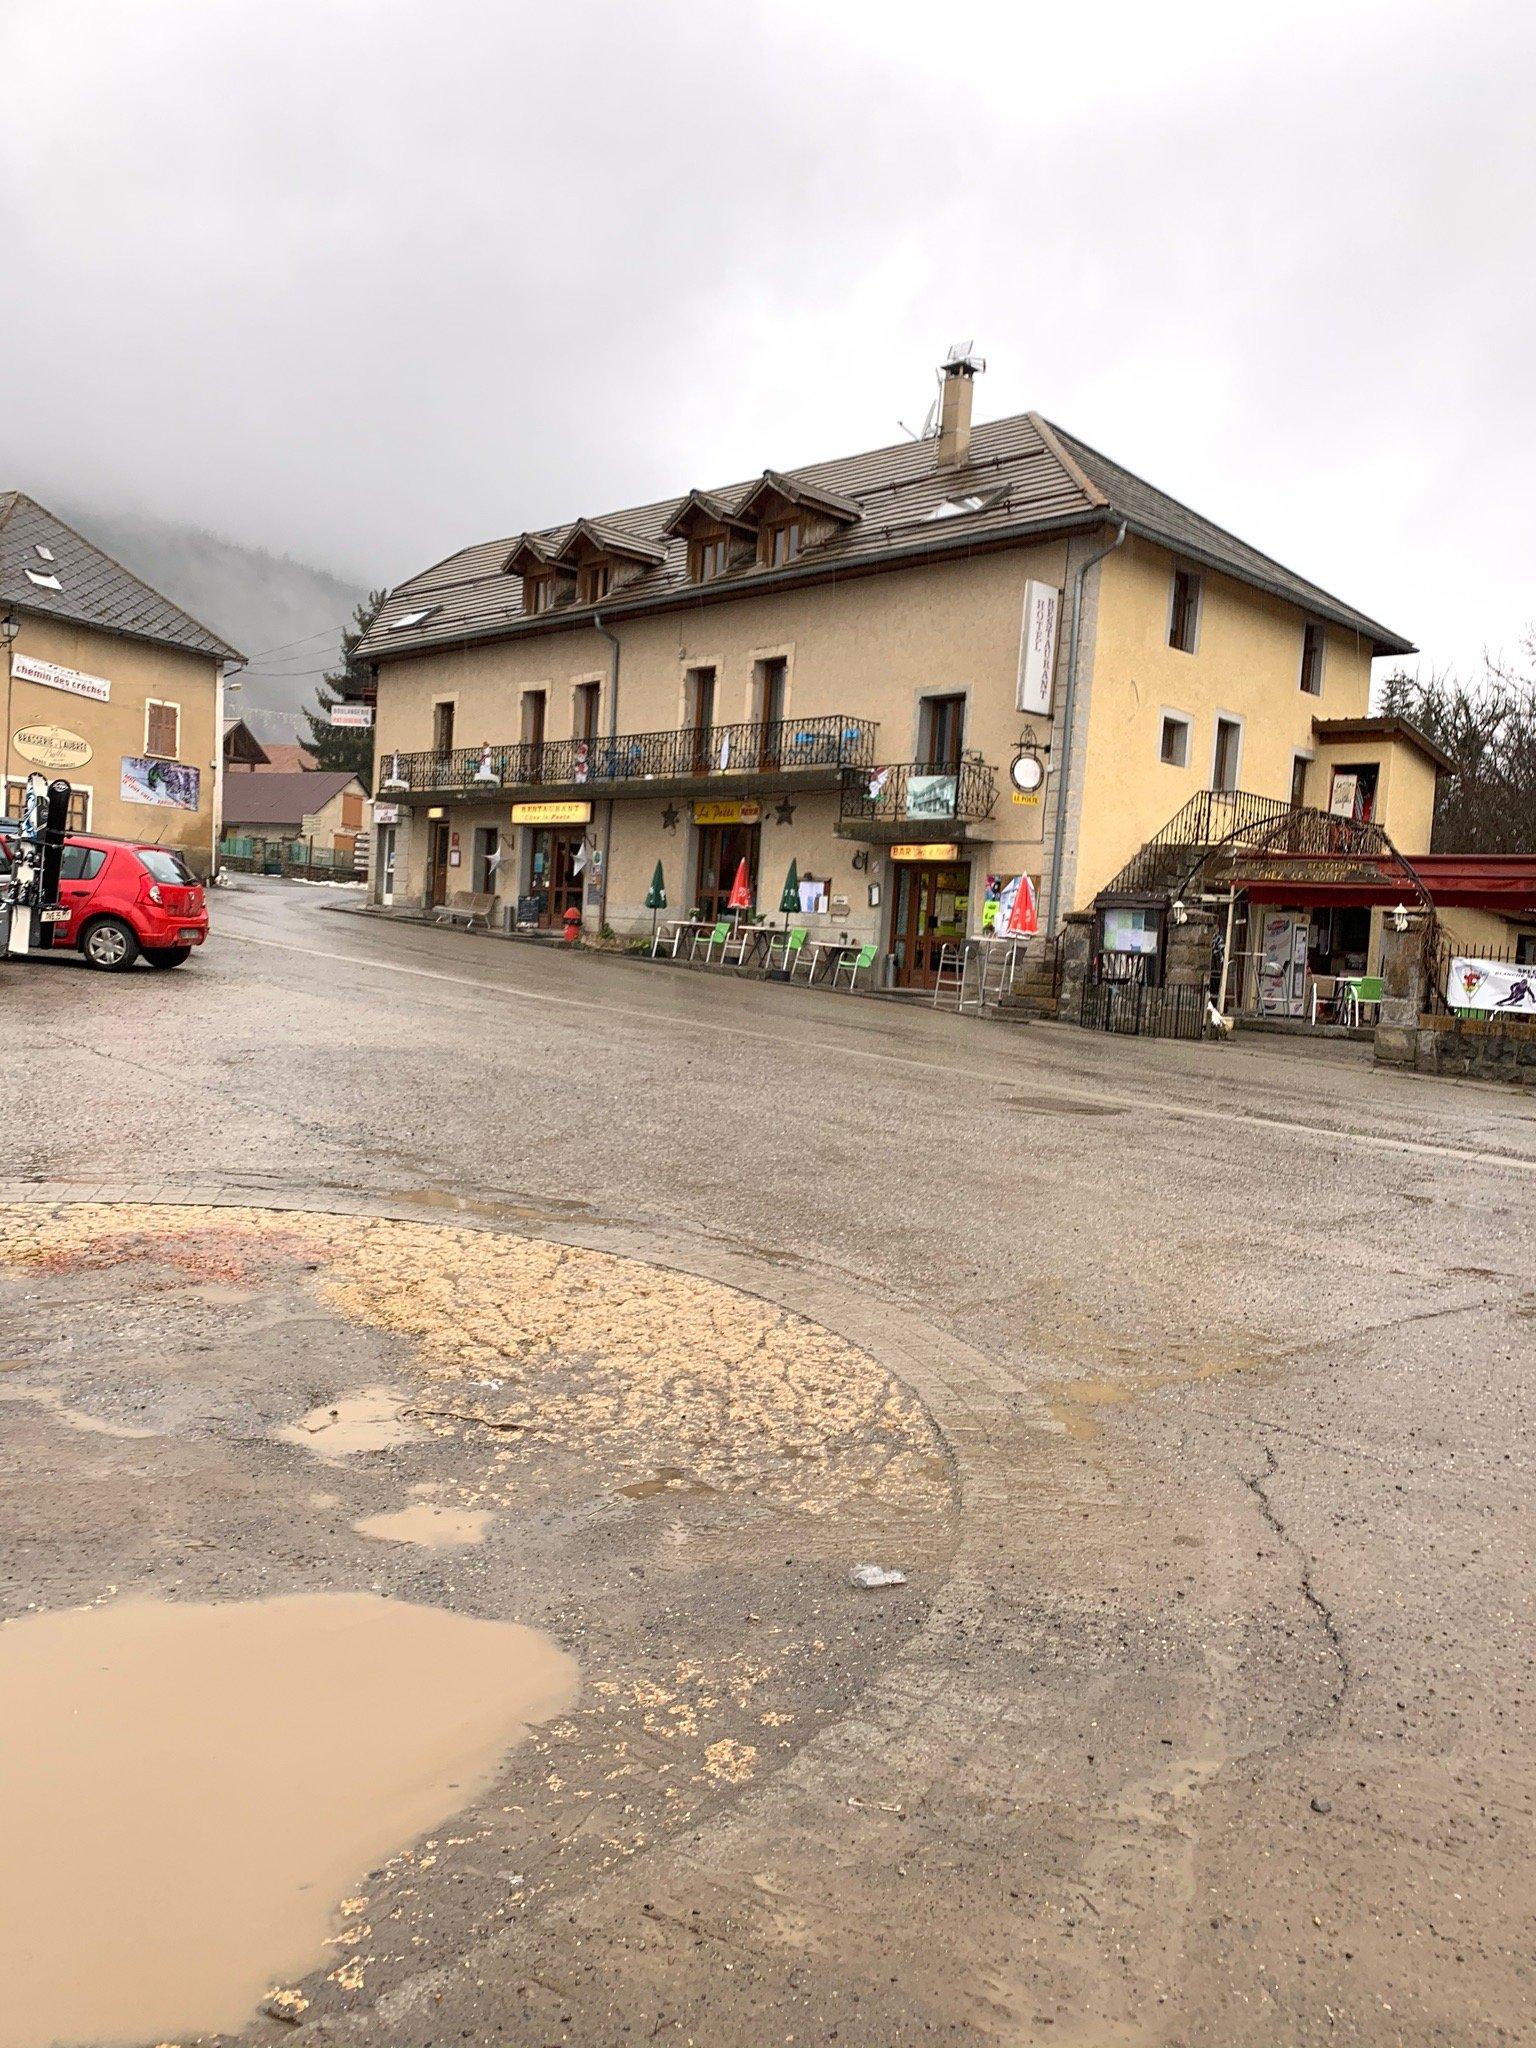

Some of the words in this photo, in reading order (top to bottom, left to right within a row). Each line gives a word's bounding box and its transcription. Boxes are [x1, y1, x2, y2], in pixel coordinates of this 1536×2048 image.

[1034, 600, 1045, 652] HOTEL
[1040, 598, 1055, 700] RESTAURANT
[16, 665, 51, 681] chemin
[54, 676, 70, 687] des
[892, 847, 912, 856] BAR
[1306, 862, 1364, 871] RESTAURANT
[1258, 871, 1284, 880] CHEZ
